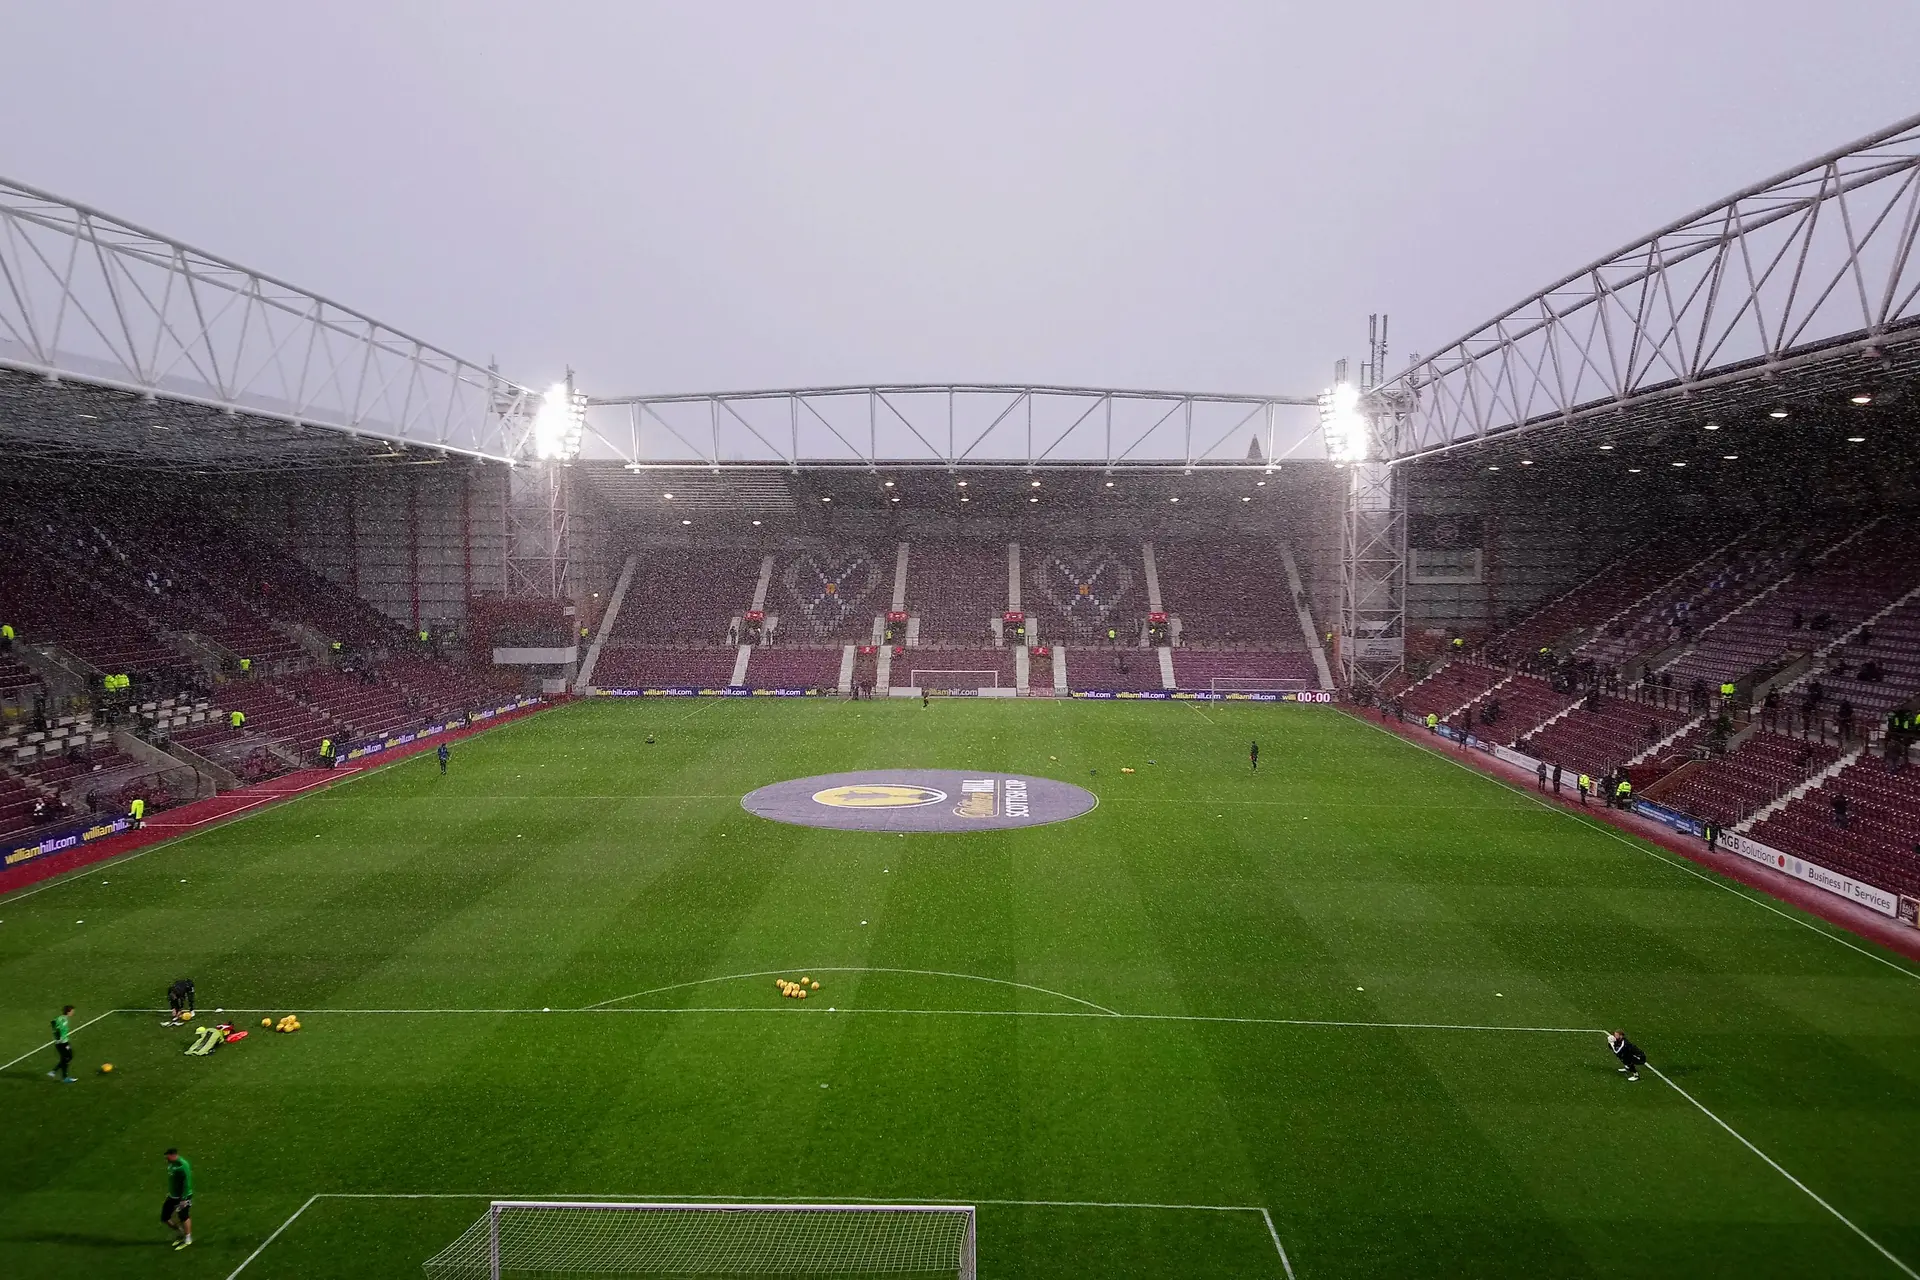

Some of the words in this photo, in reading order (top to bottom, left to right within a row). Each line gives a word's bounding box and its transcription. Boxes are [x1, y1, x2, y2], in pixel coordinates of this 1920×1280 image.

[698, 688, 747, 696] williamhill.com
[752, 688, 801, 696] williamhill.com
[1115, 691, 1165, 699] williamhill.com
[1297, 692, 1331, 703] 00:00
[5, 835, 76, 865] williamhill.com
[1720, 833, 1740, 850] RGB
[1741, 840, 1776, 864] Solutions
[1808, 867, 1841, 890] Business
[1843, 881, 1853, 893] IT
[1855, 885, 1891, 909] Services
